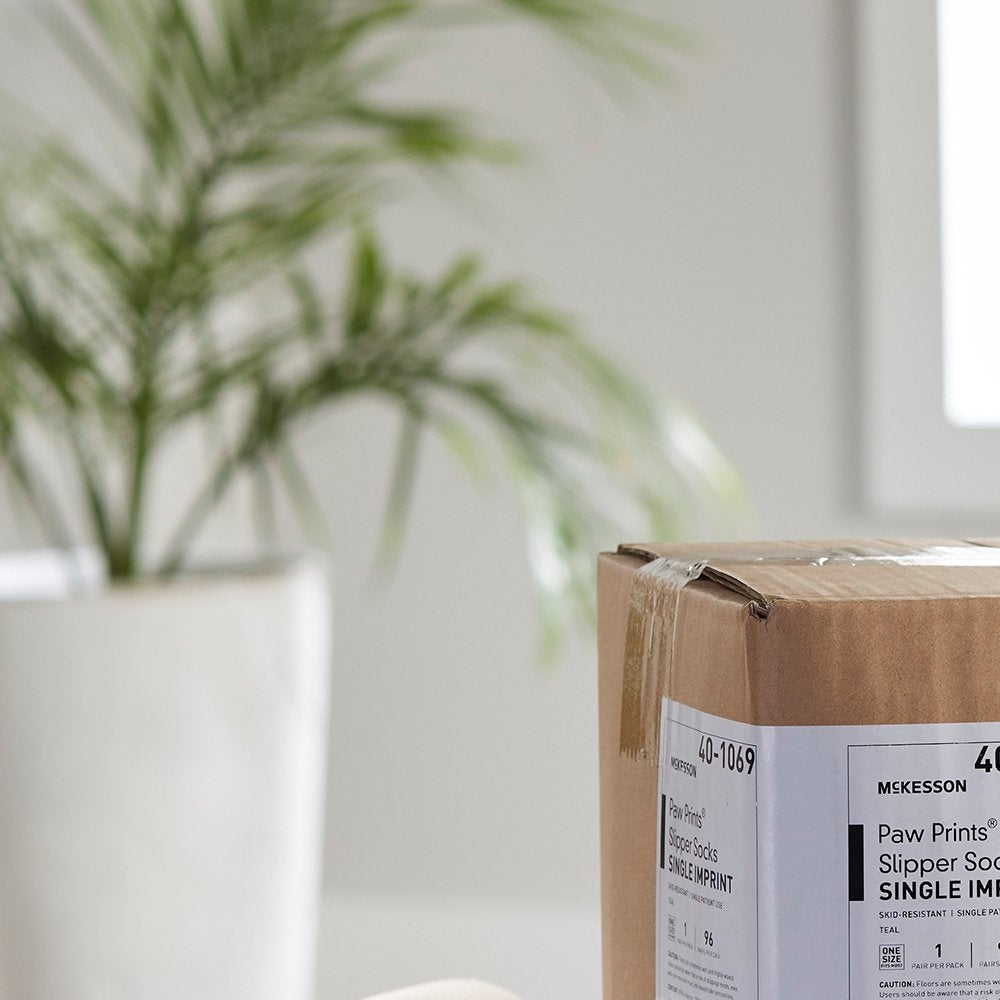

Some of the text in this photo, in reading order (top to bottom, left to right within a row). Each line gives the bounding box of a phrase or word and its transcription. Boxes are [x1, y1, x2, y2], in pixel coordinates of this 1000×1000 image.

[698, 736, 756, 775] 40-1069
[668, 798, 683, 822] Paw
[878, 823, 924, 844] Paw
[668, 827, 718, 864] Slipper Socks
[879, 853, 958, 878] Slipper
[668, 854, 694, 882] SINGLE
[694, 864, 734, 894] IMPRINT
[879, 880, 962, 901] SINGLE
[878, 909, 946, 919] SKID-RESISTANT
[957, 908, 987, 917] SINGLE
[879, 926, 900, 934] TEAL
[704, 930, 714, 947] 96
[882, 946, 901, 955] ONE
[934, 943, 942, 958] 1
[882, 955, 902, 963] SIZE
[979, 960, 1000, 968] PAIRS
[878, 980, 915, 988] CAUTION:
[916, 980, 939, 988] Floors
[901, 990, 926, 998] should
[980, 988, 994, 996] risk
